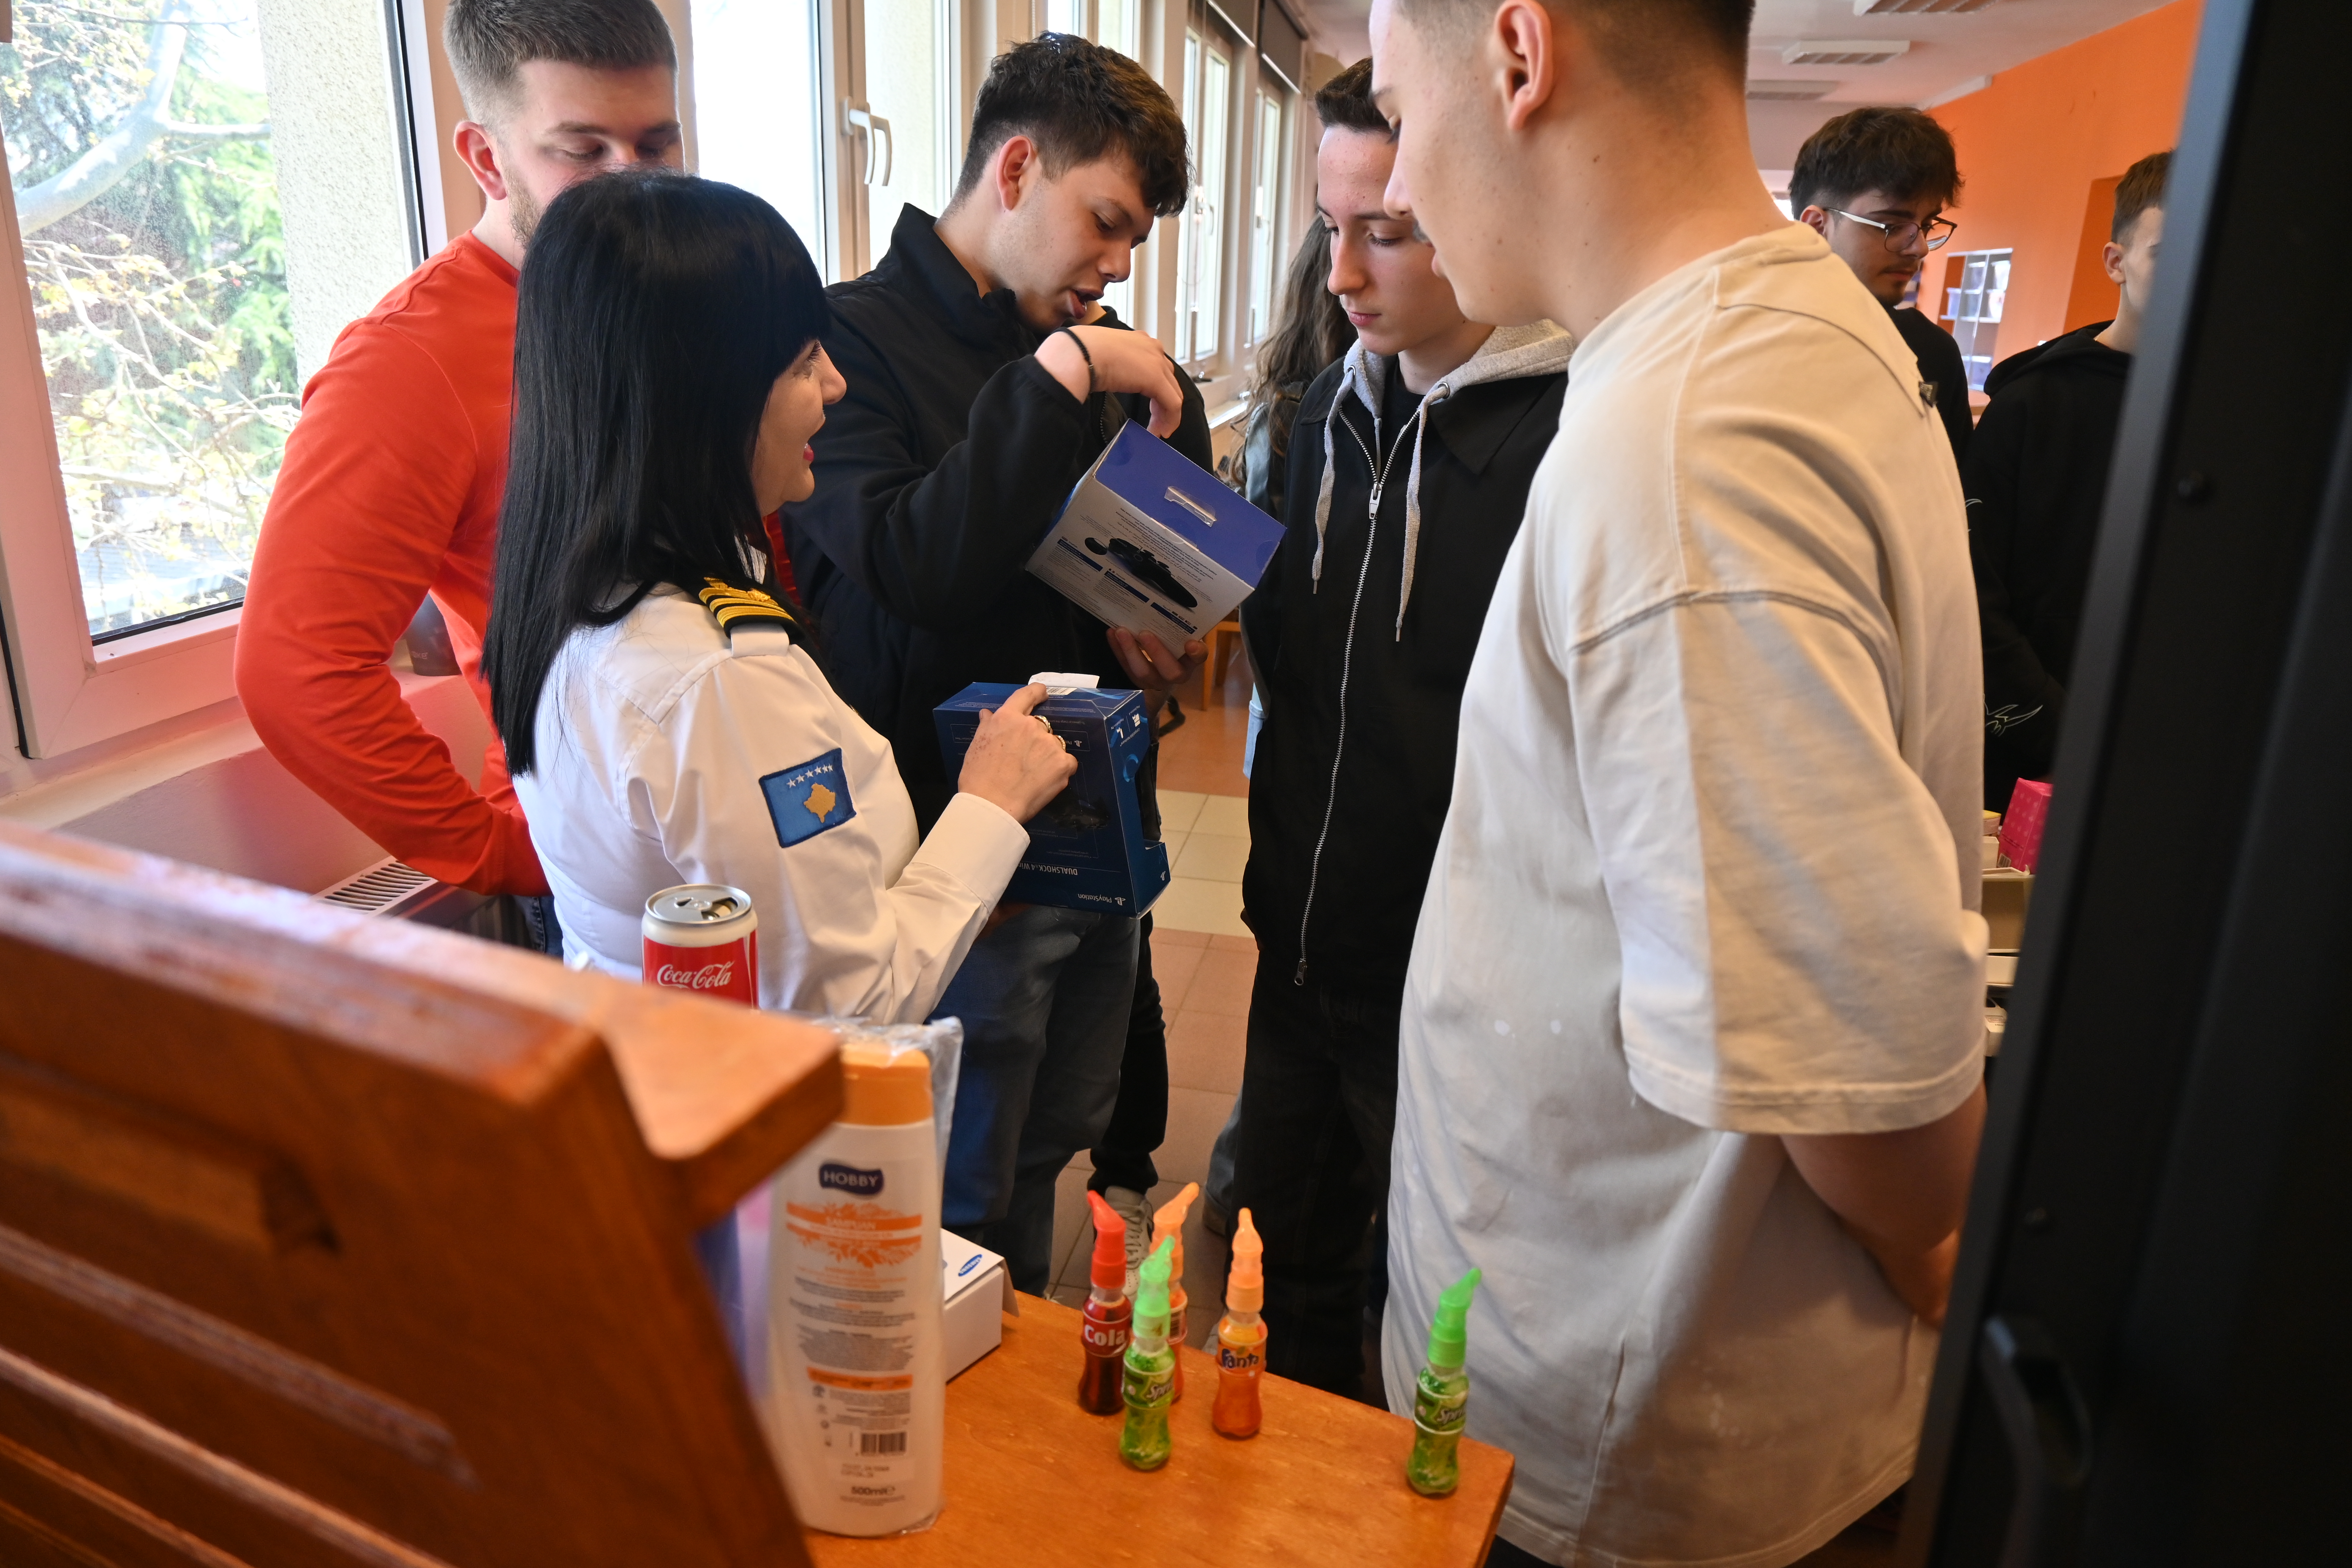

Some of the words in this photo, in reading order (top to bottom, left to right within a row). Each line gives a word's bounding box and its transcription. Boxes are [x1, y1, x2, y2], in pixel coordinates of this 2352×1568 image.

[1077, 893, 1112, 903] PlayStation
[824, 1169, 879, 1187] HOBBY
[1084, 1324, 1125, 1347] Cola
